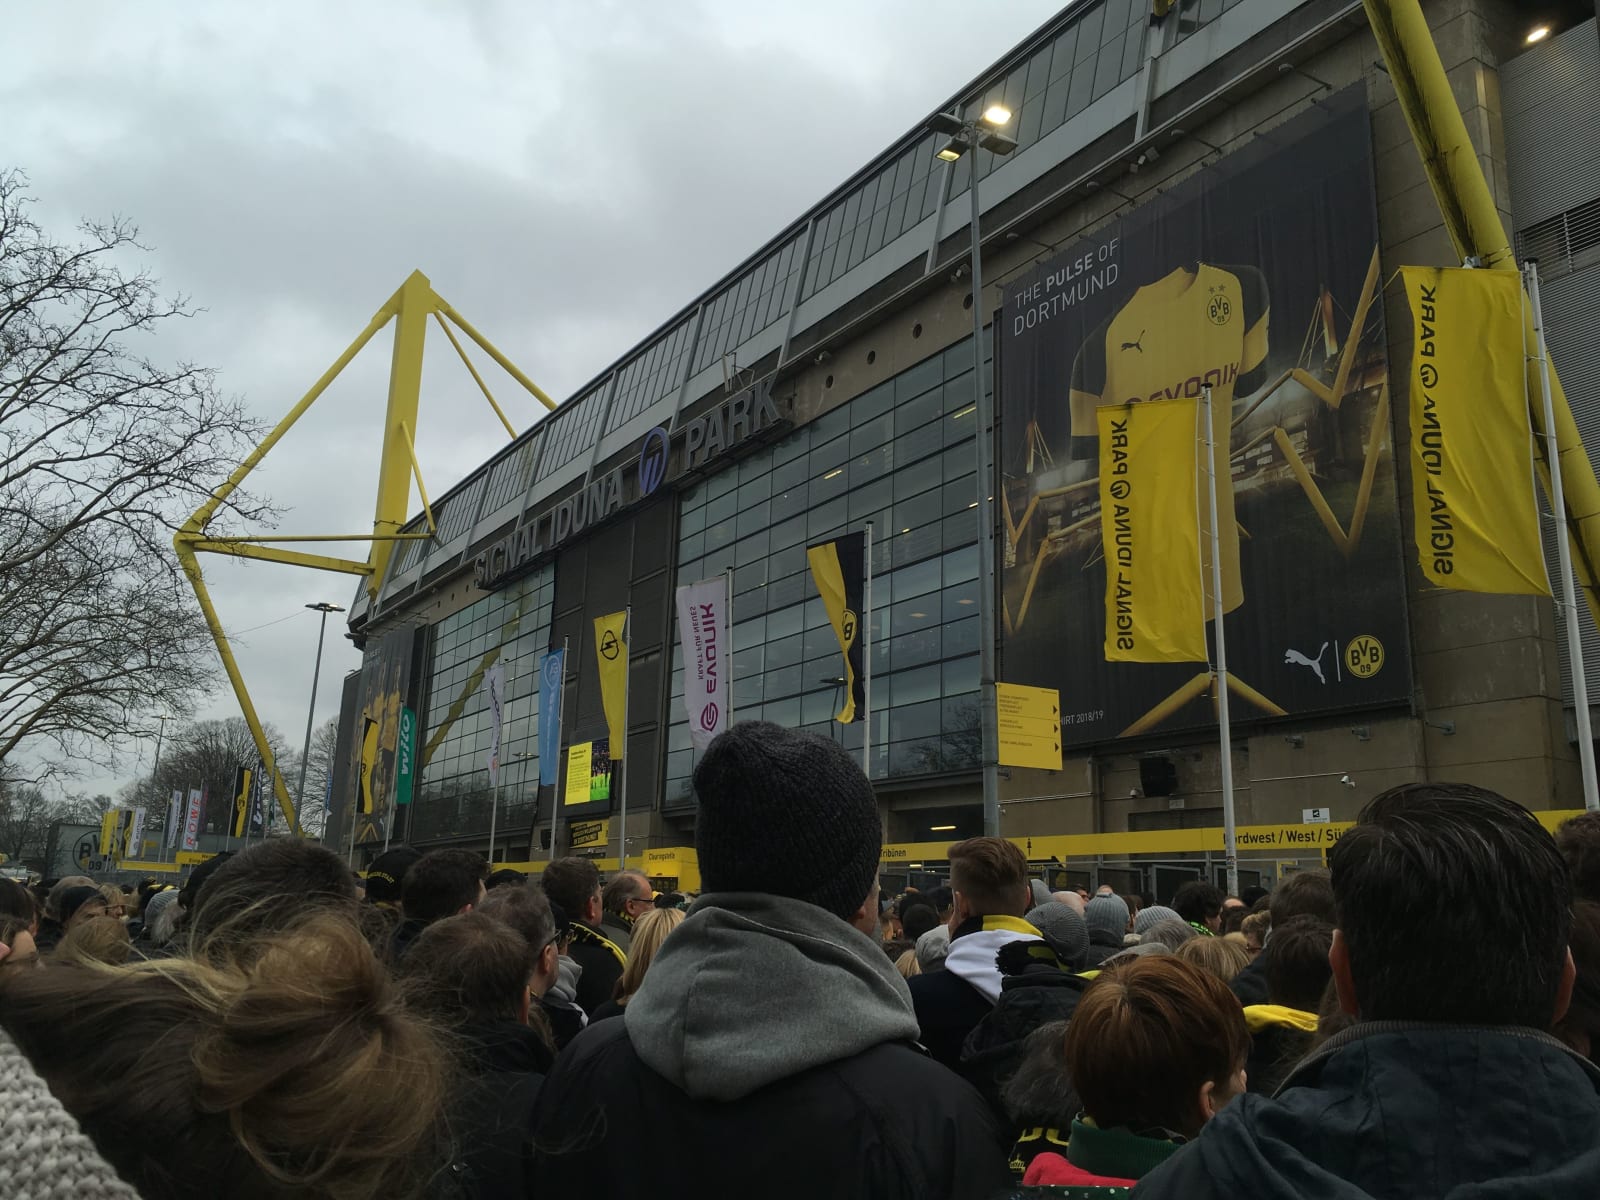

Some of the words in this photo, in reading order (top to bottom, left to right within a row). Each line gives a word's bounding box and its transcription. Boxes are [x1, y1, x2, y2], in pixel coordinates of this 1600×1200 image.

[1015, 281, 1042, 309] THE
[1045, 252, 1094, 293] PULSE
[1097, 238, 1119, 263] OF
[1014, 263, 1120, 337] DORTMUND
[1211, 297, 1230, 318] BVB
[473, 518, 543, 588] SIGNAL
[550, 468, 625, 544] IDUNA
[685, 378, 782, 470] PARK
[1351, 640, 1380, 667] BVB
[1360, 663, 1371, 673] 09
[1076, 709, 1104, 724] 2018/19
[186, 797, 200, 847] ROWE
[1223, 832, 1275, 845] rdwest
[1286, 830, 1315, 843] West
[1326, 828, 1346, 842] Sü
